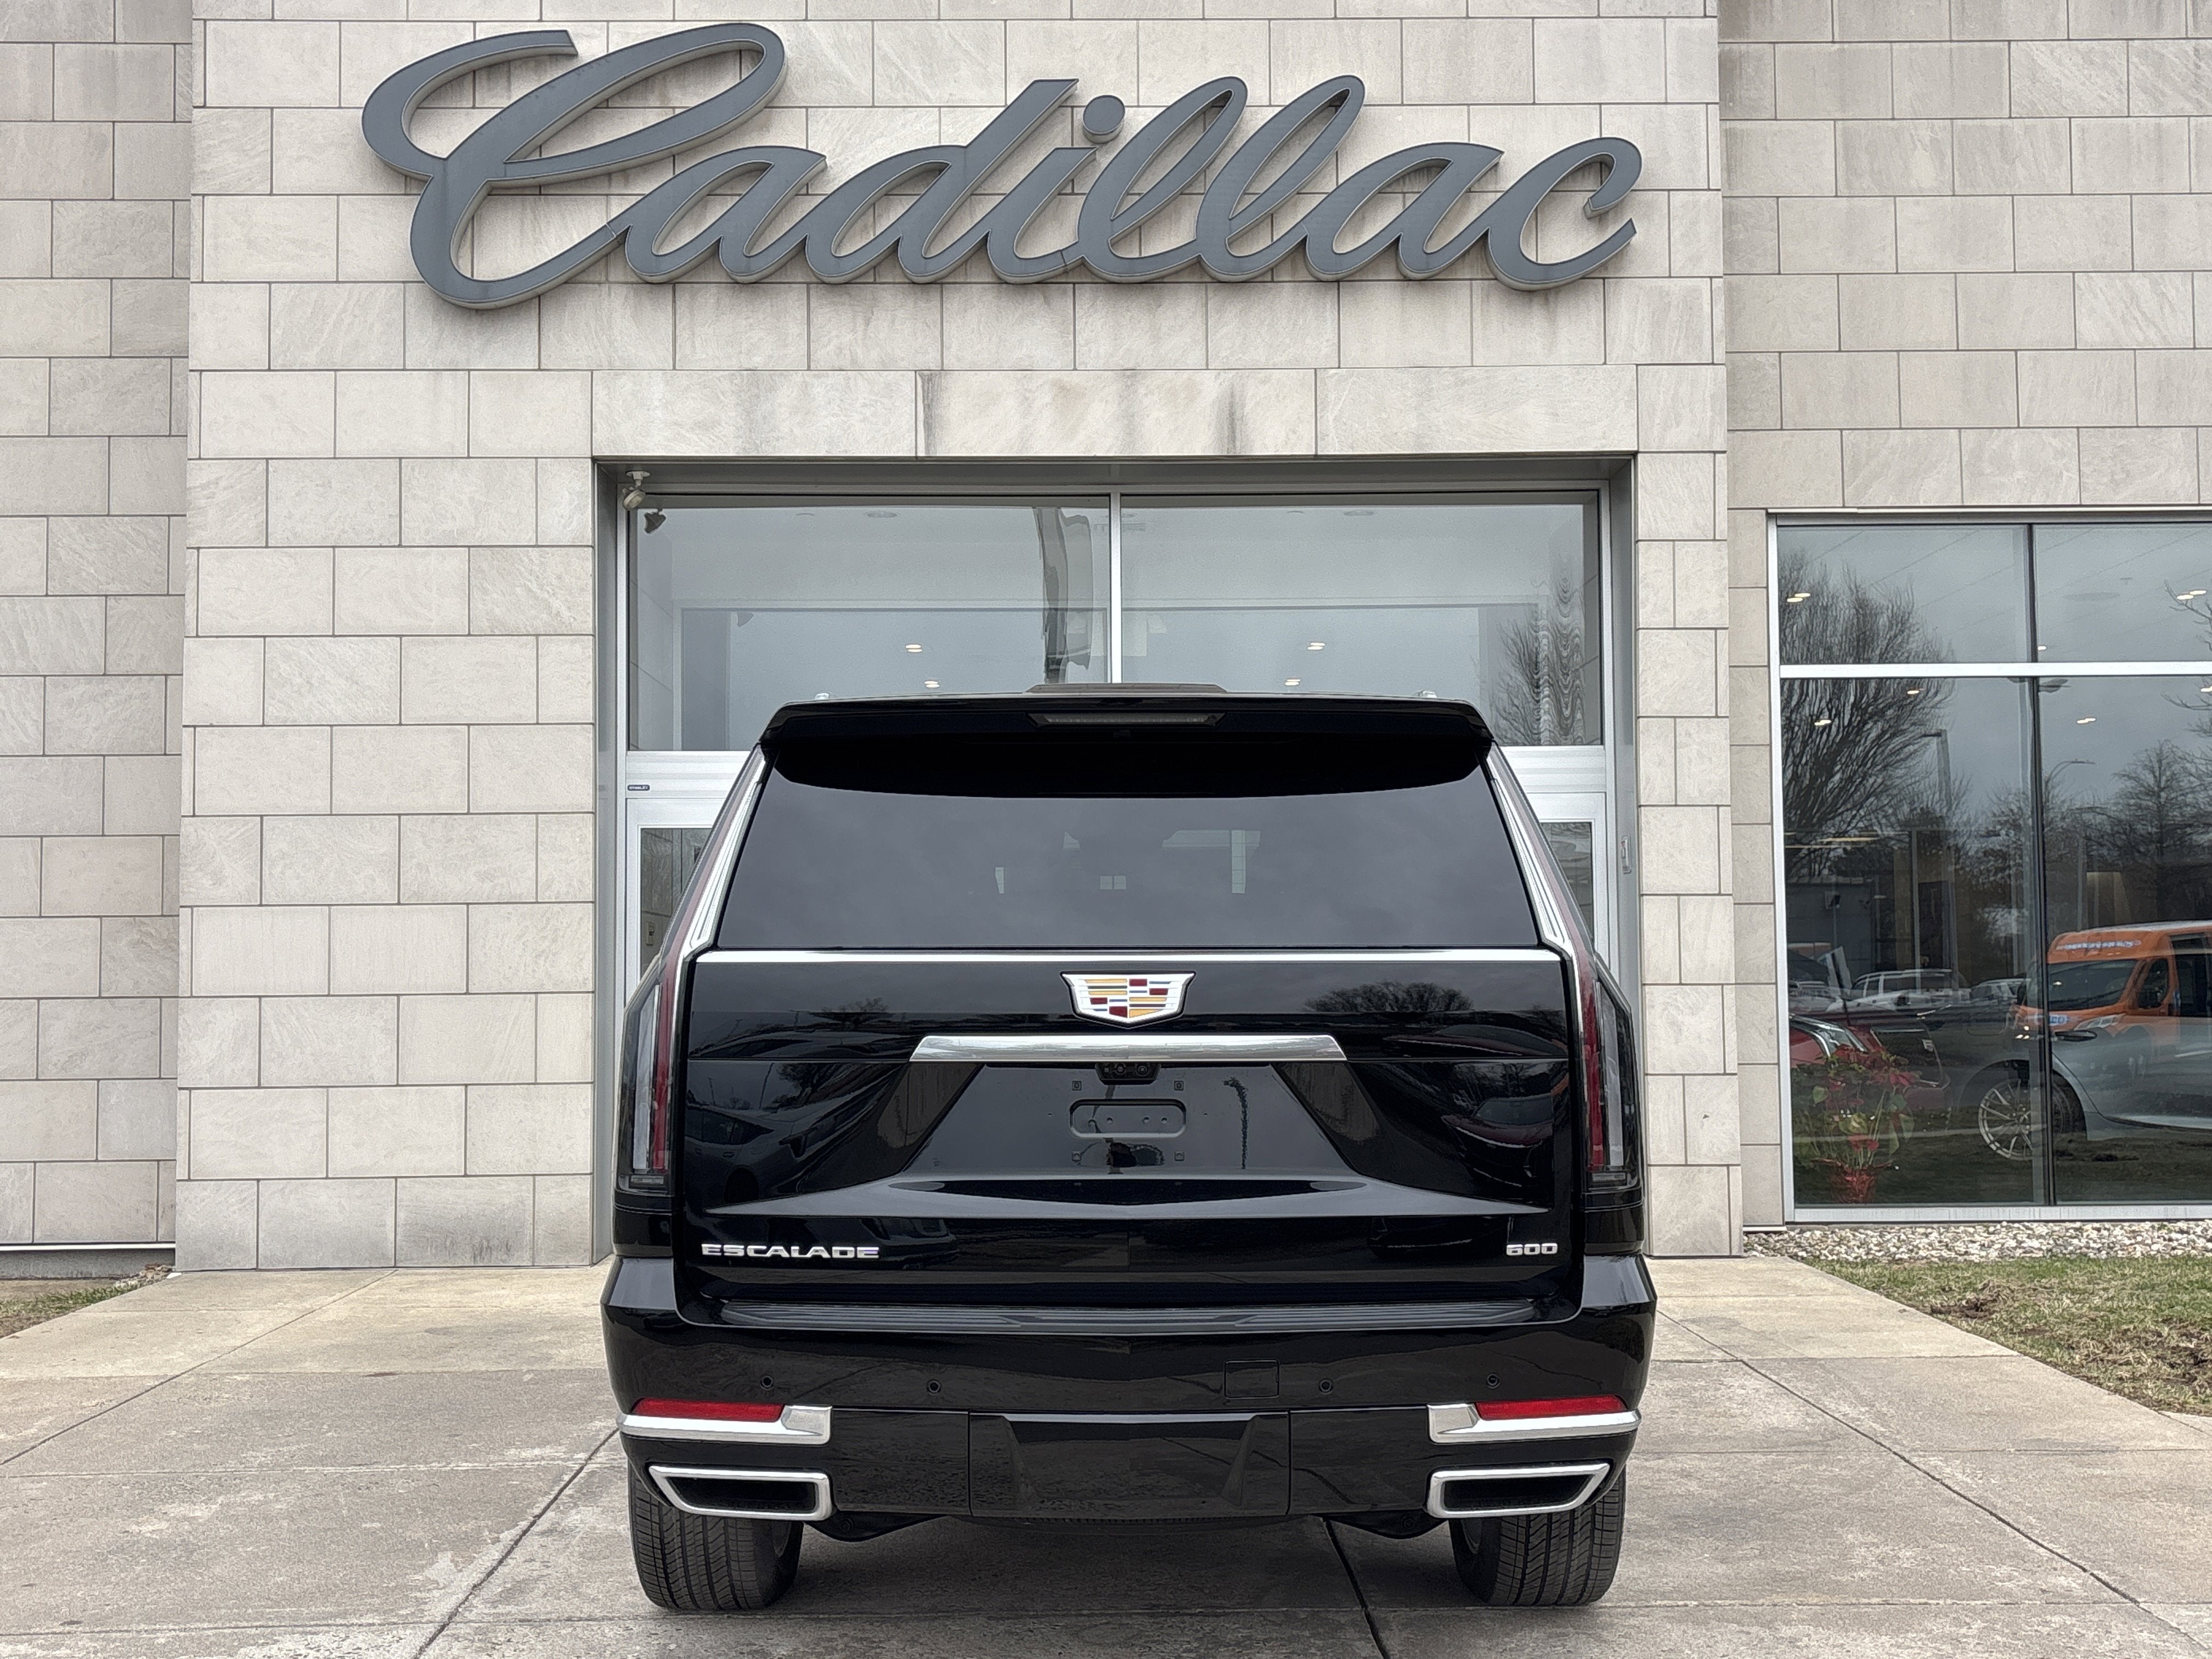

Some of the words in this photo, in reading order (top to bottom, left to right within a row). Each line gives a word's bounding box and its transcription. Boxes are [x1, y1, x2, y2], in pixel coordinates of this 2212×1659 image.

[362, 22, 1642, 309] Cadillac
[701, 1244, 879, 1259] ESCALADE
[1506, 1243, 1558, 1256] 600
